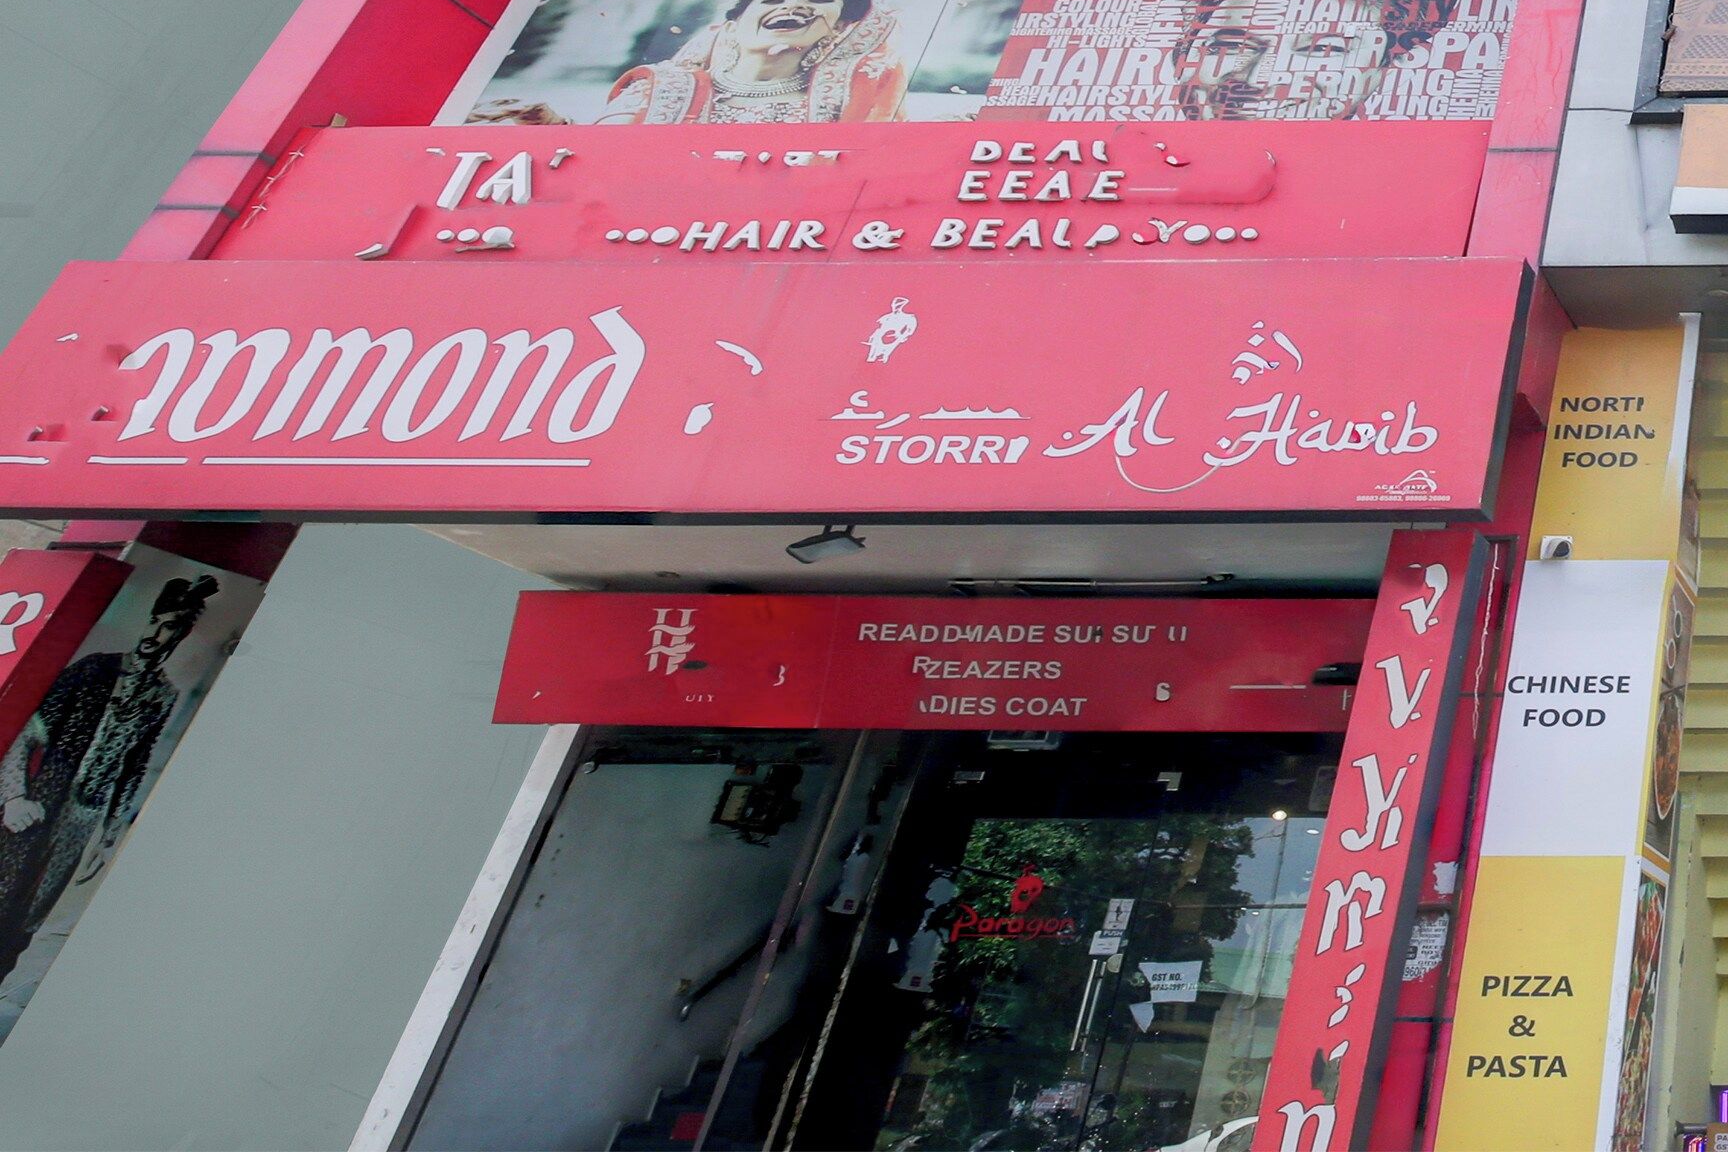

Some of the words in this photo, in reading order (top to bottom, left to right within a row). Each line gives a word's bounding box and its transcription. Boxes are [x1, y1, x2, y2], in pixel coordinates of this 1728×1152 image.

[1281, 20, 1327, 34] HEAD
[851, 219, 905, 251] &
[1561, 451, 1639, 469] FOOD
[1507, 675, 1632, 695] CHINESE
[1005, 696, 1088, 717] COAT
[1522, 708, 1607, 728] FOOD
[1150, 972, 1168, 982] GST
[1480, 975, 1574, 998] PIZZA
[1508, 1014, 1536, 1038] &
[1465, 1055, 1568, 1078] PASTA
